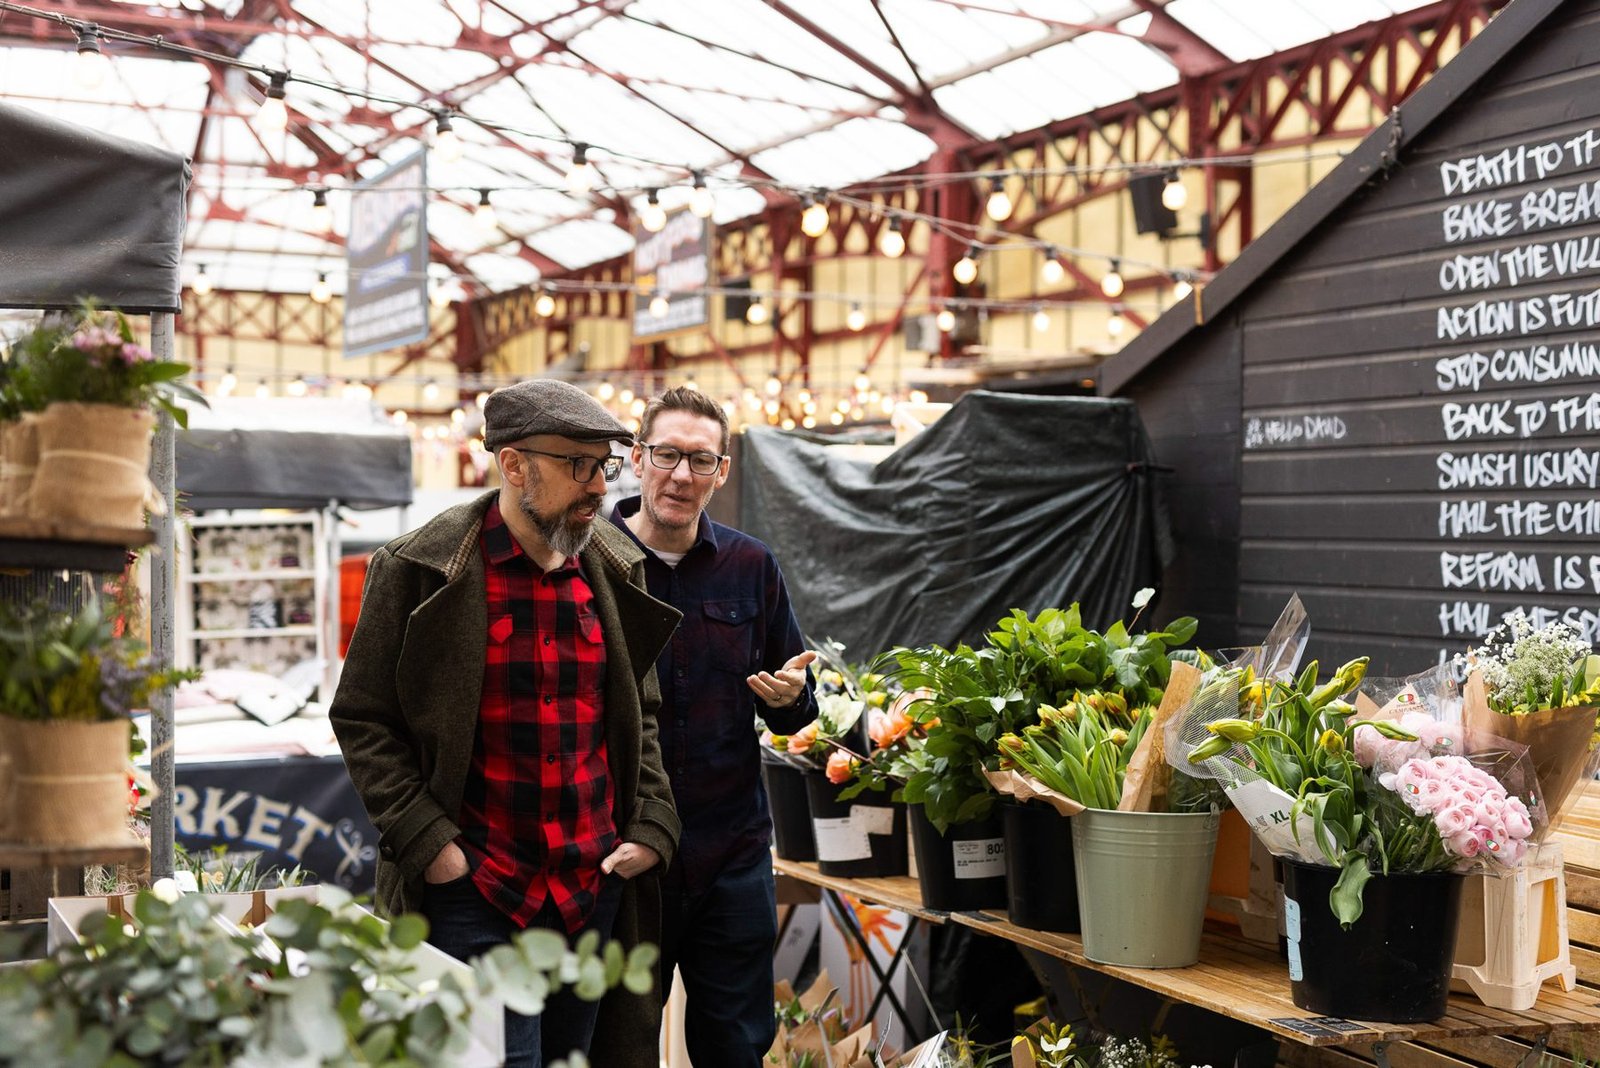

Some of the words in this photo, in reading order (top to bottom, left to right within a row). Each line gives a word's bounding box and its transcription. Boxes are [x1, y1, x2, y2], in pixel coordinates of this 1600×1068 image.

[1440, 145, 1526, 196] DEATH
[1526, 142, 1563, 179] TO
[1443, 200, 1518, 243] BAKE
[1439, 249, 1500, 291] OPEN
[1500, 244, 1553, 286] THE
[1437, 300, 1514, 340] ACTION
[1519, 297, 1547, 334] IS
[1436, 351, 1490, 391] STOP
[1442, 399, 1515, 440] BACK
[1514, 400, 1547, 438] TO
[1436, 452, 1517, 490] SMASH
[1523, 447, 1599, 489] USURY
[1438, 500, 1497, 538] HAIL
[1494, 500, 1555, 537] THE
[1440, 551, 1545, 592] REFORM
[1553, 555, 1586, 592] IS
[1438, 601, 1501, 638] HAIL
